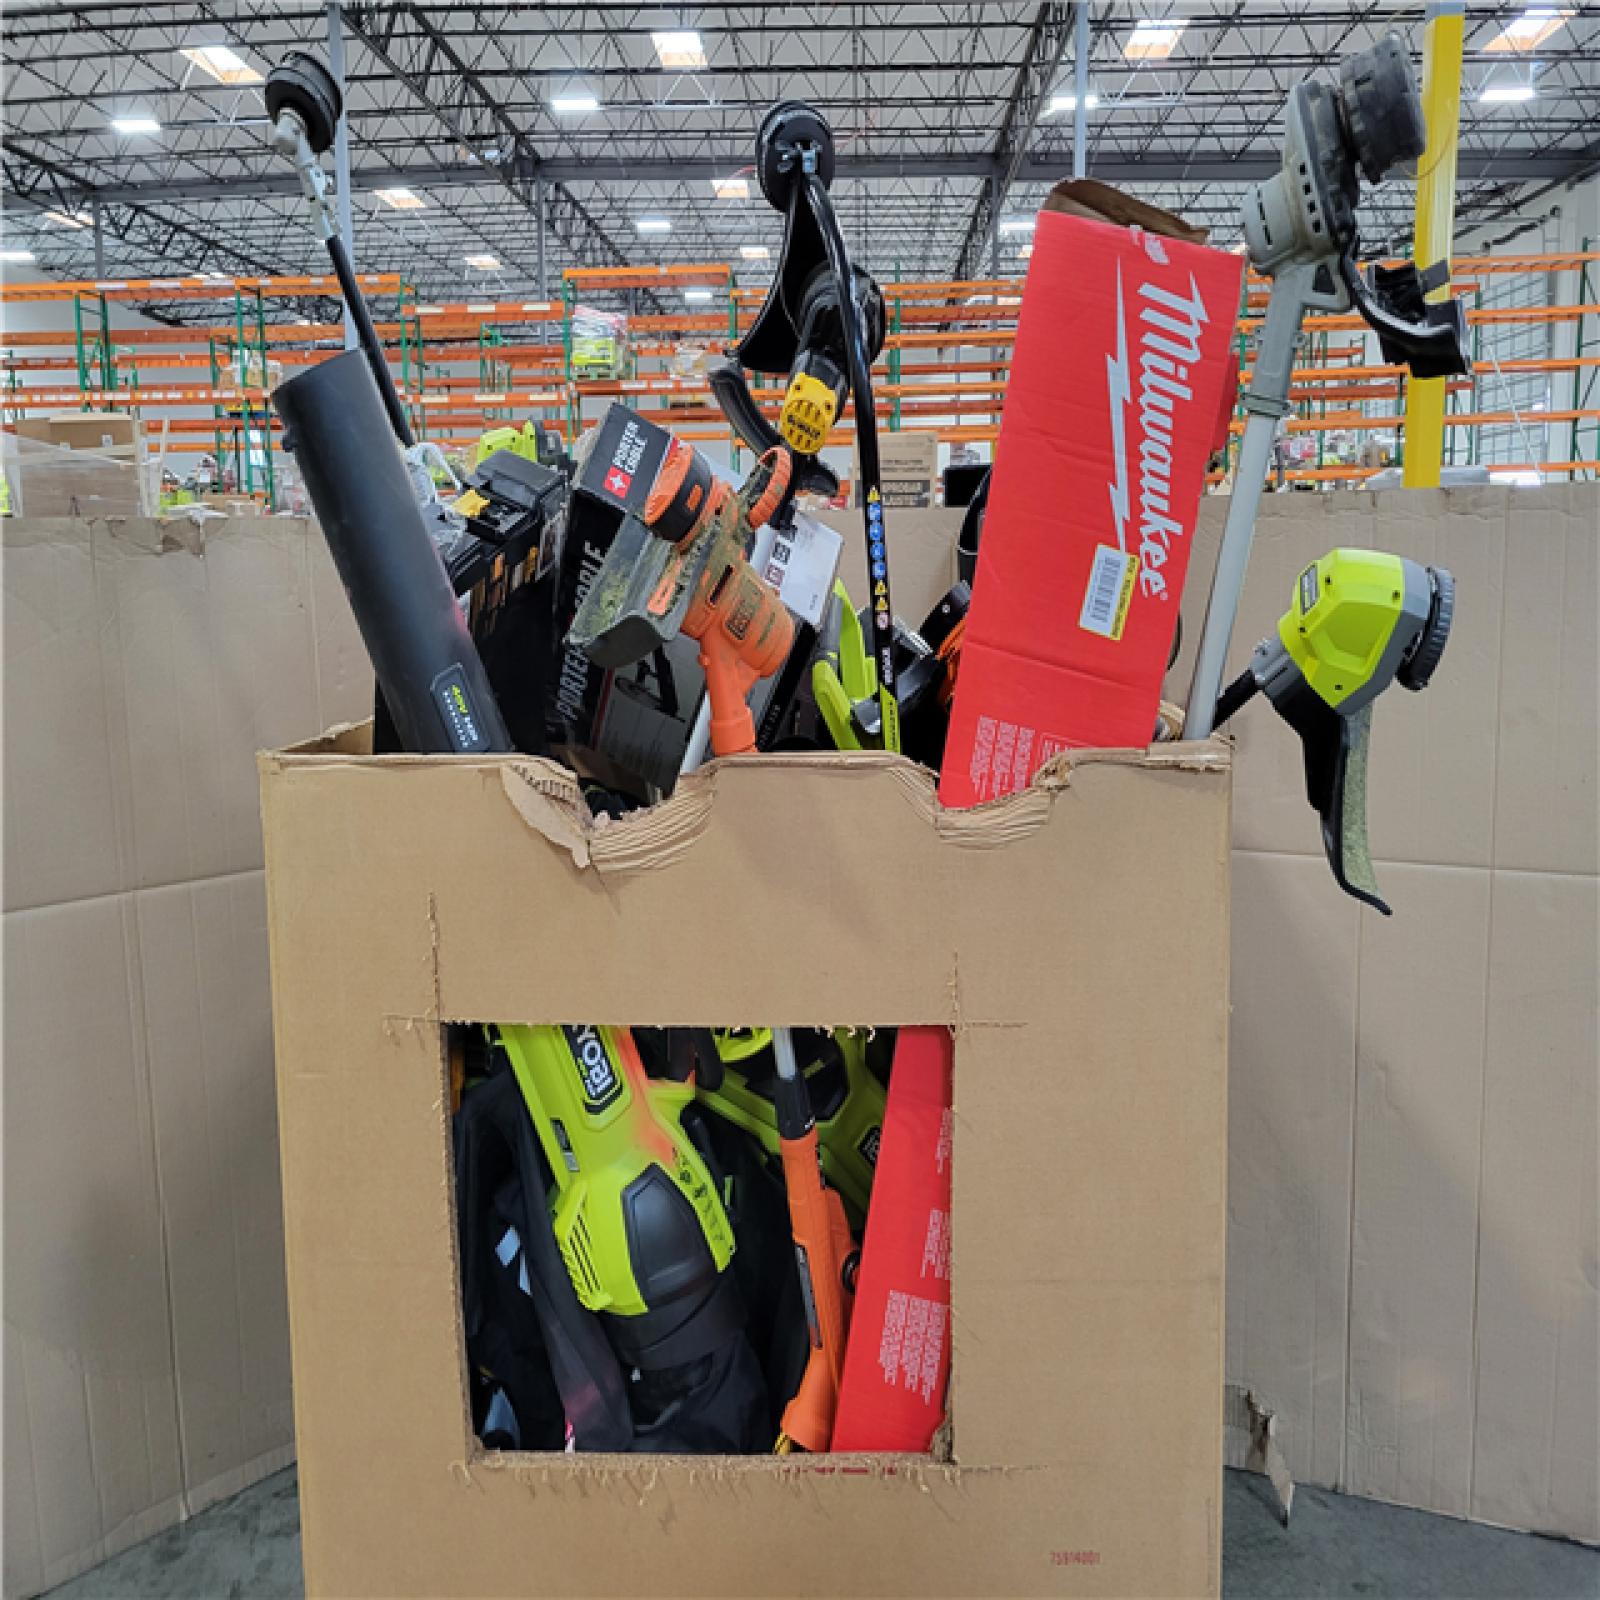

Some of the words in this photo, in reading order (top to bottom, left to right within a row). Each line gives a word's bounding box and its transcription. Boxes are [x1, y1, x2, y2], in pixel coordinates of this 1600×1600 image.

[612, 421, 640, 467] PORTER
[624, 437, 648, 475] CABLE
[1137, 270, 1210, 600] Milwaukee
[572, 1025, 613, 1097] YOBI
